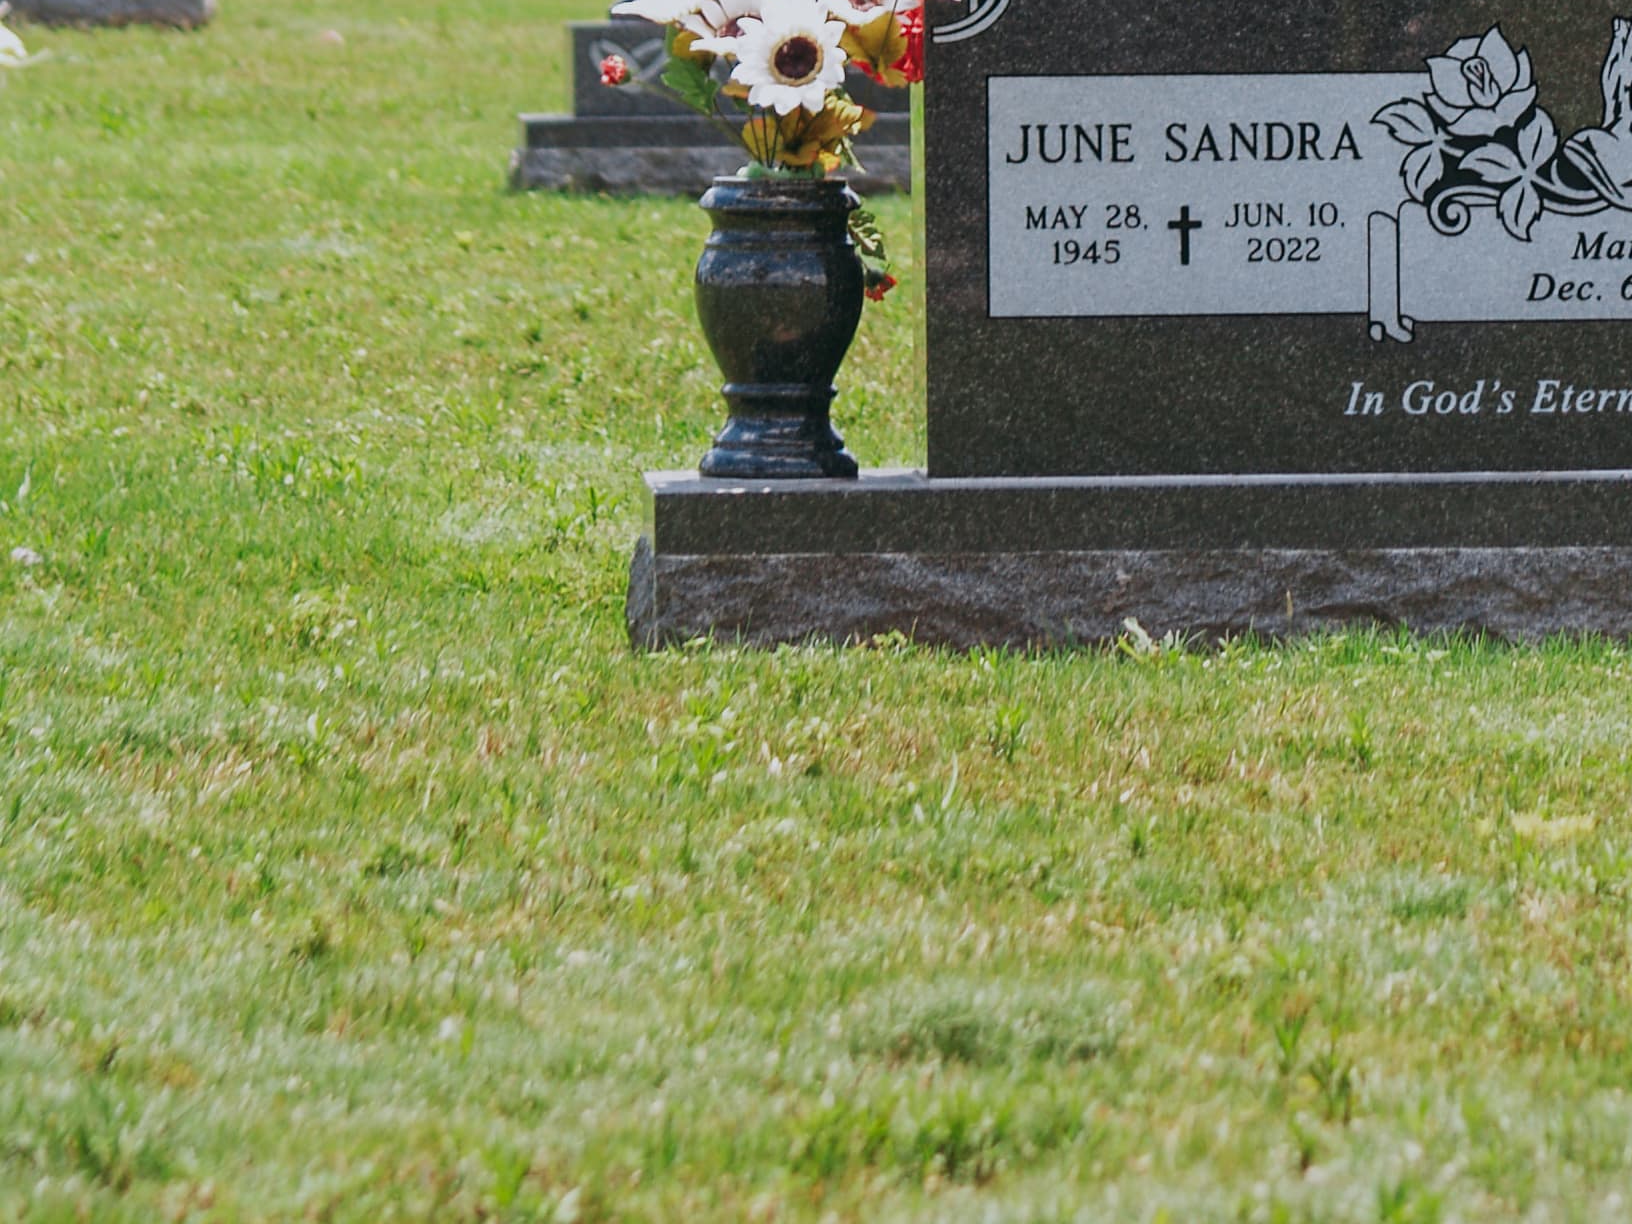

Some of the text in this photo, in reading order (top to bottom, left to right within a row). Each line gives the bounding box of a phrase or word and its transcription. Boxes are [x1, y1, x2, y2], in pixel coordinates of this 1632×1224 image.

[1005, 122, 1363, 164] JUNE SANDRA
[1026, 204, 1088, 230] MAY
[1224, 202, 1293, 228] JUN.
[1053, 239, 1121, 265] 1945
[1247, 237, 1321, 263] 2022
[1526, 272, 1602, 302] Dec.
[1343, 381, 1384, 416] In
[1402, 379, 1516, 415] God's
